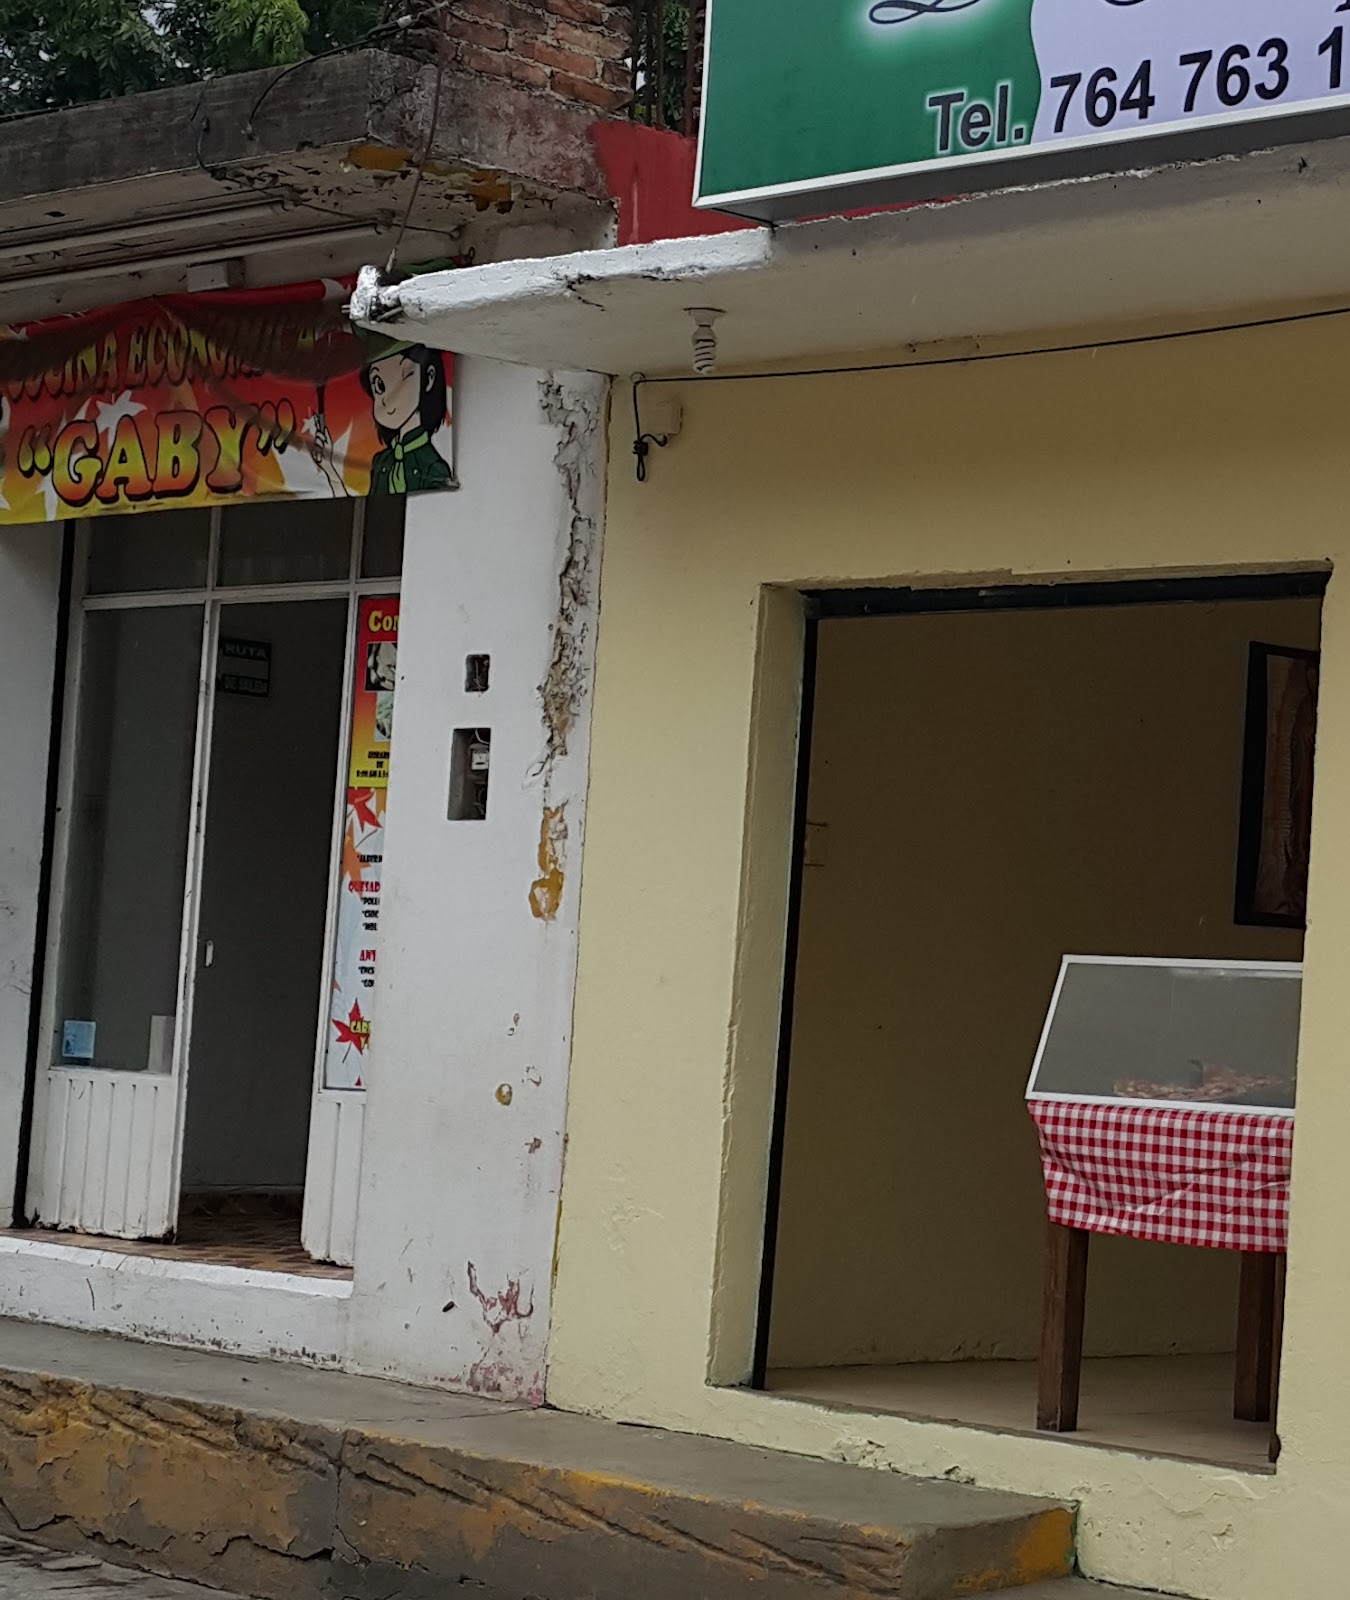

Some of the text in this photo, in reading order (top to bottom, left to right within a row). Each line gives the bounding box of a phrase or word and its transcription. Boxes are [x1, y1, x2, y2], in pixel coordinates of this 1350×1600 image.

[928, 82, 1026, 154] Tel.
[1051, 59, 1155, 135] 764
[1178, 37, 1290, 114] 763
